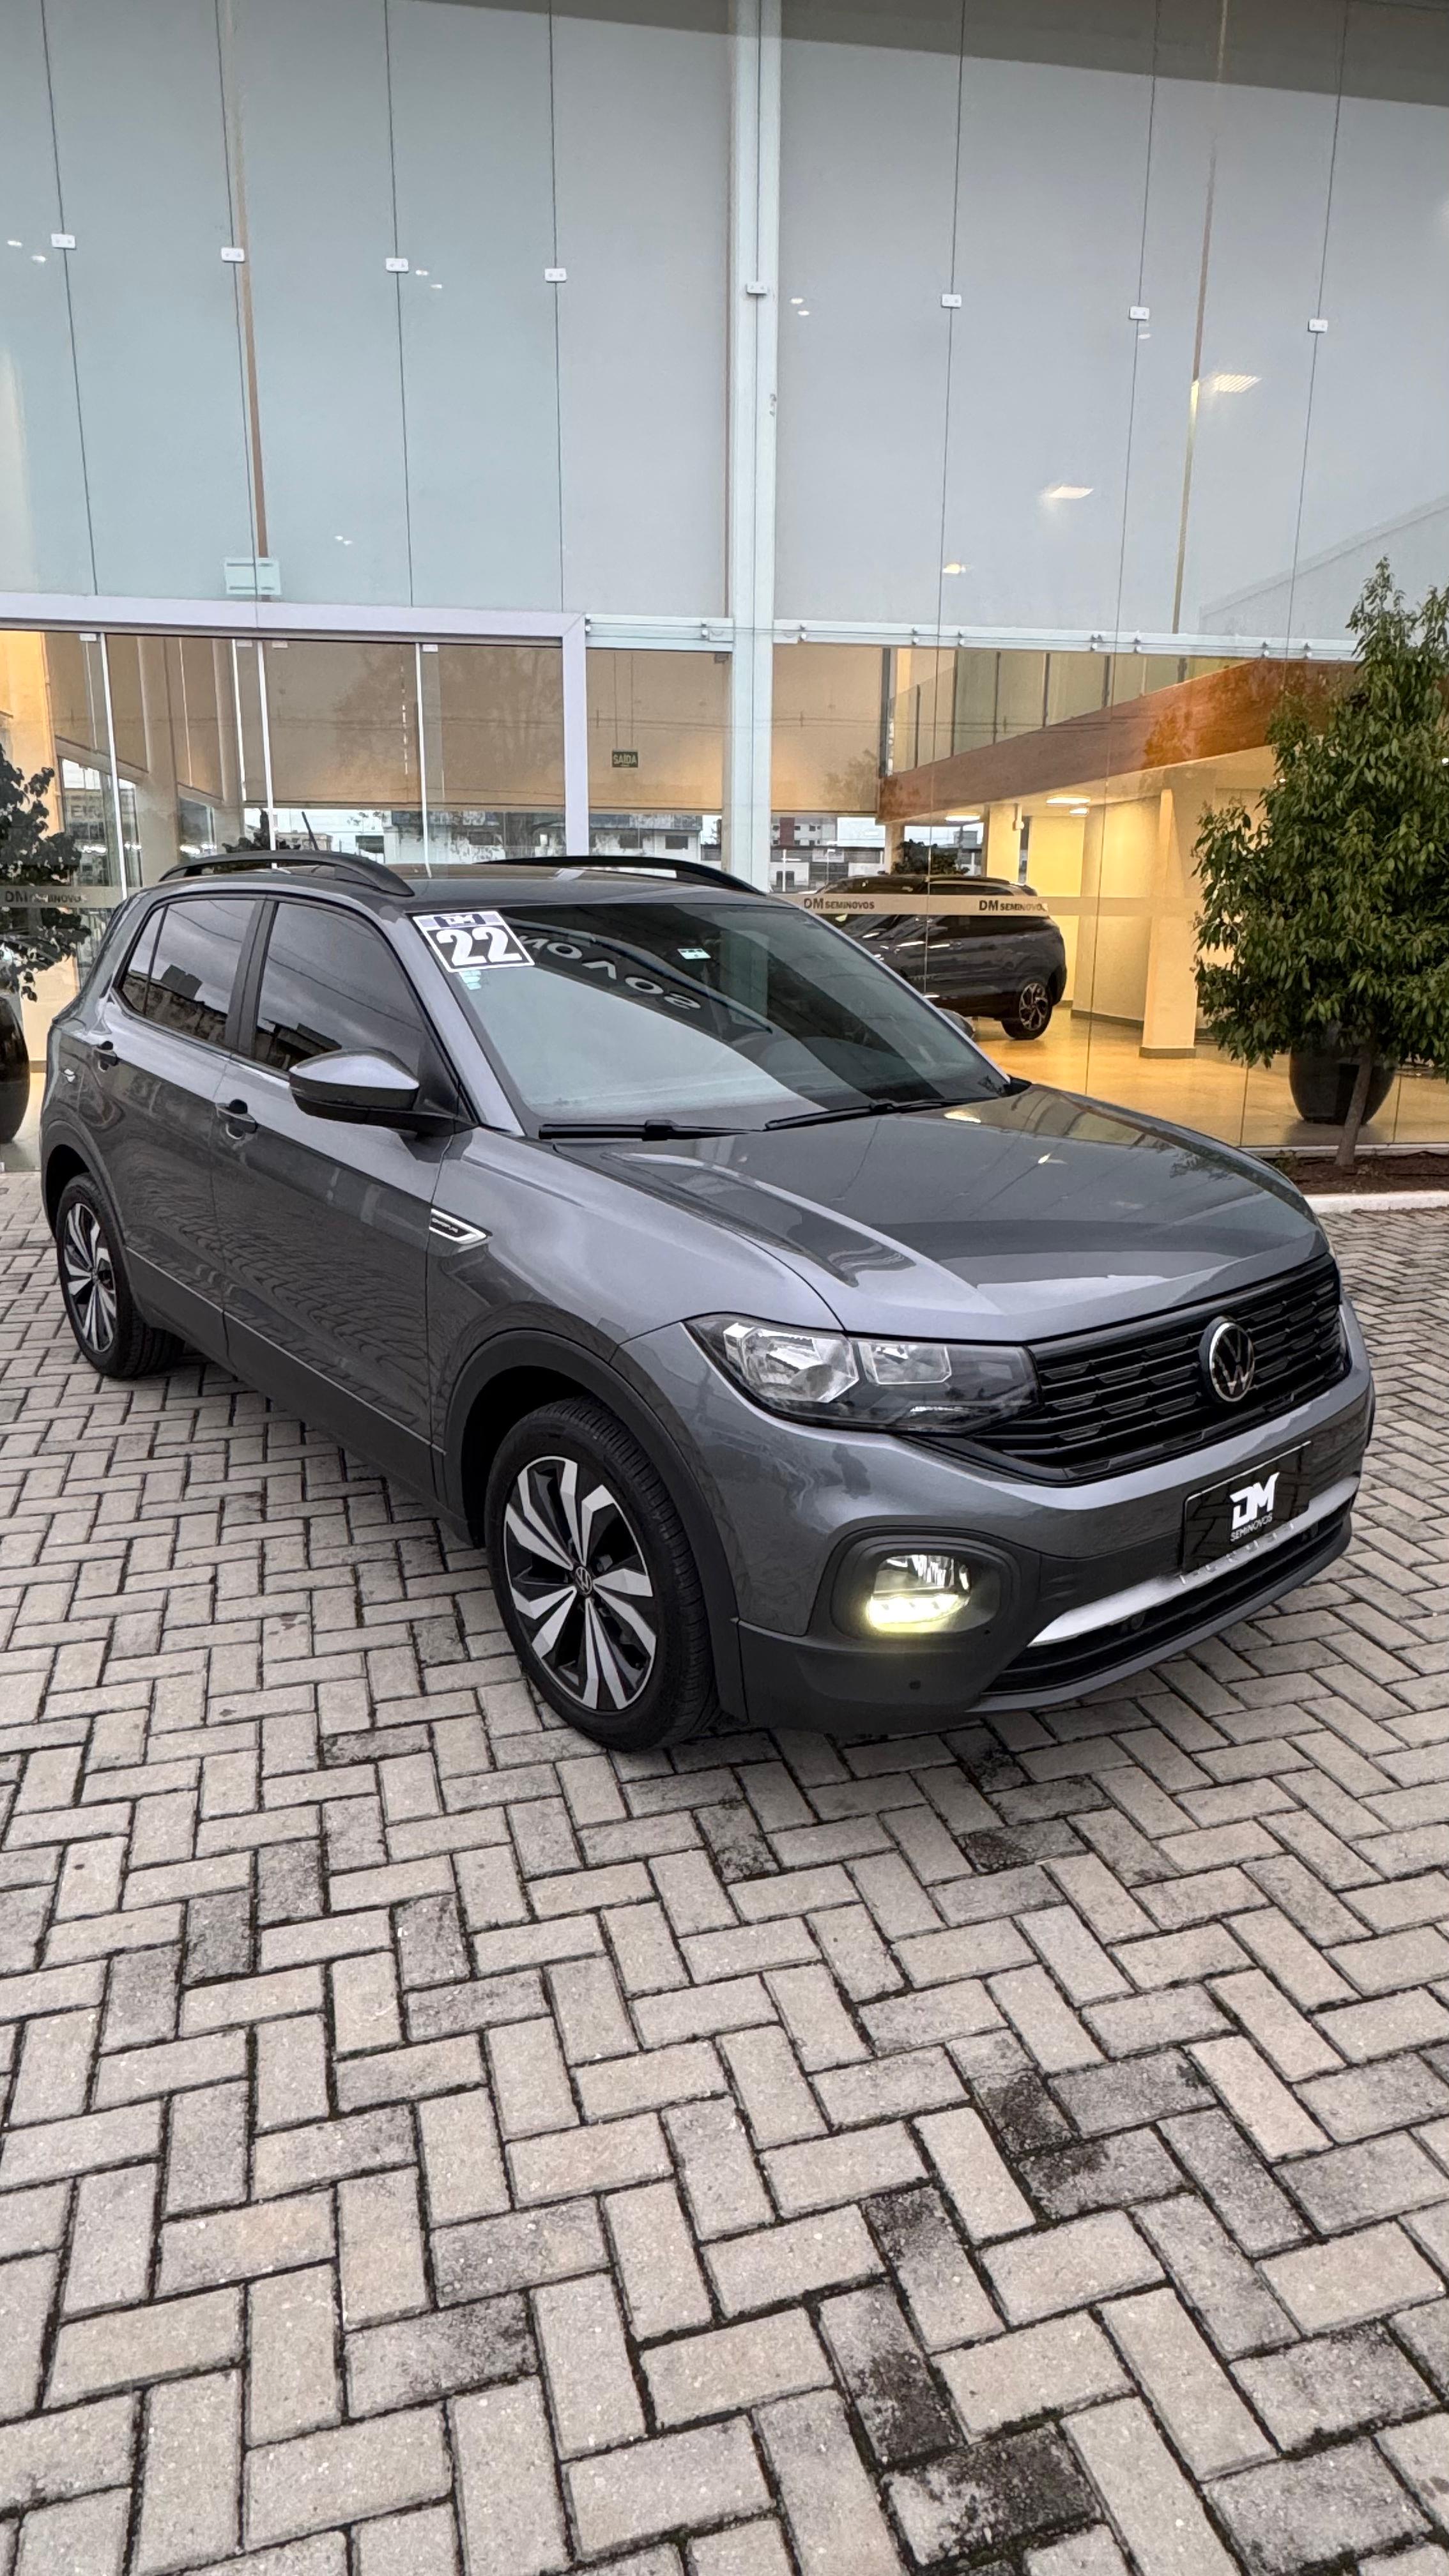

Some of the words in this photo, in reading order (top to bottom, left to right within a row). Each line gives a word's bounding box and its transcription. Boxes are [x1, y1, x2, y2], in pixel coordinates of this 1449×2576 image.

[613, 753, 636, 765] SAÍDA
[5, 891, 27, 903] DM
[804, 897, 824, 909] DM
[825, 901, 875, 910] SEMINOVOS
[979, 900, 999, 911] DM
[436, 927, 522, 965] 22
[1230, 1472, 1280, 1530] DM
[1230, 1512, 1273, 1542] SEMINOVOS
